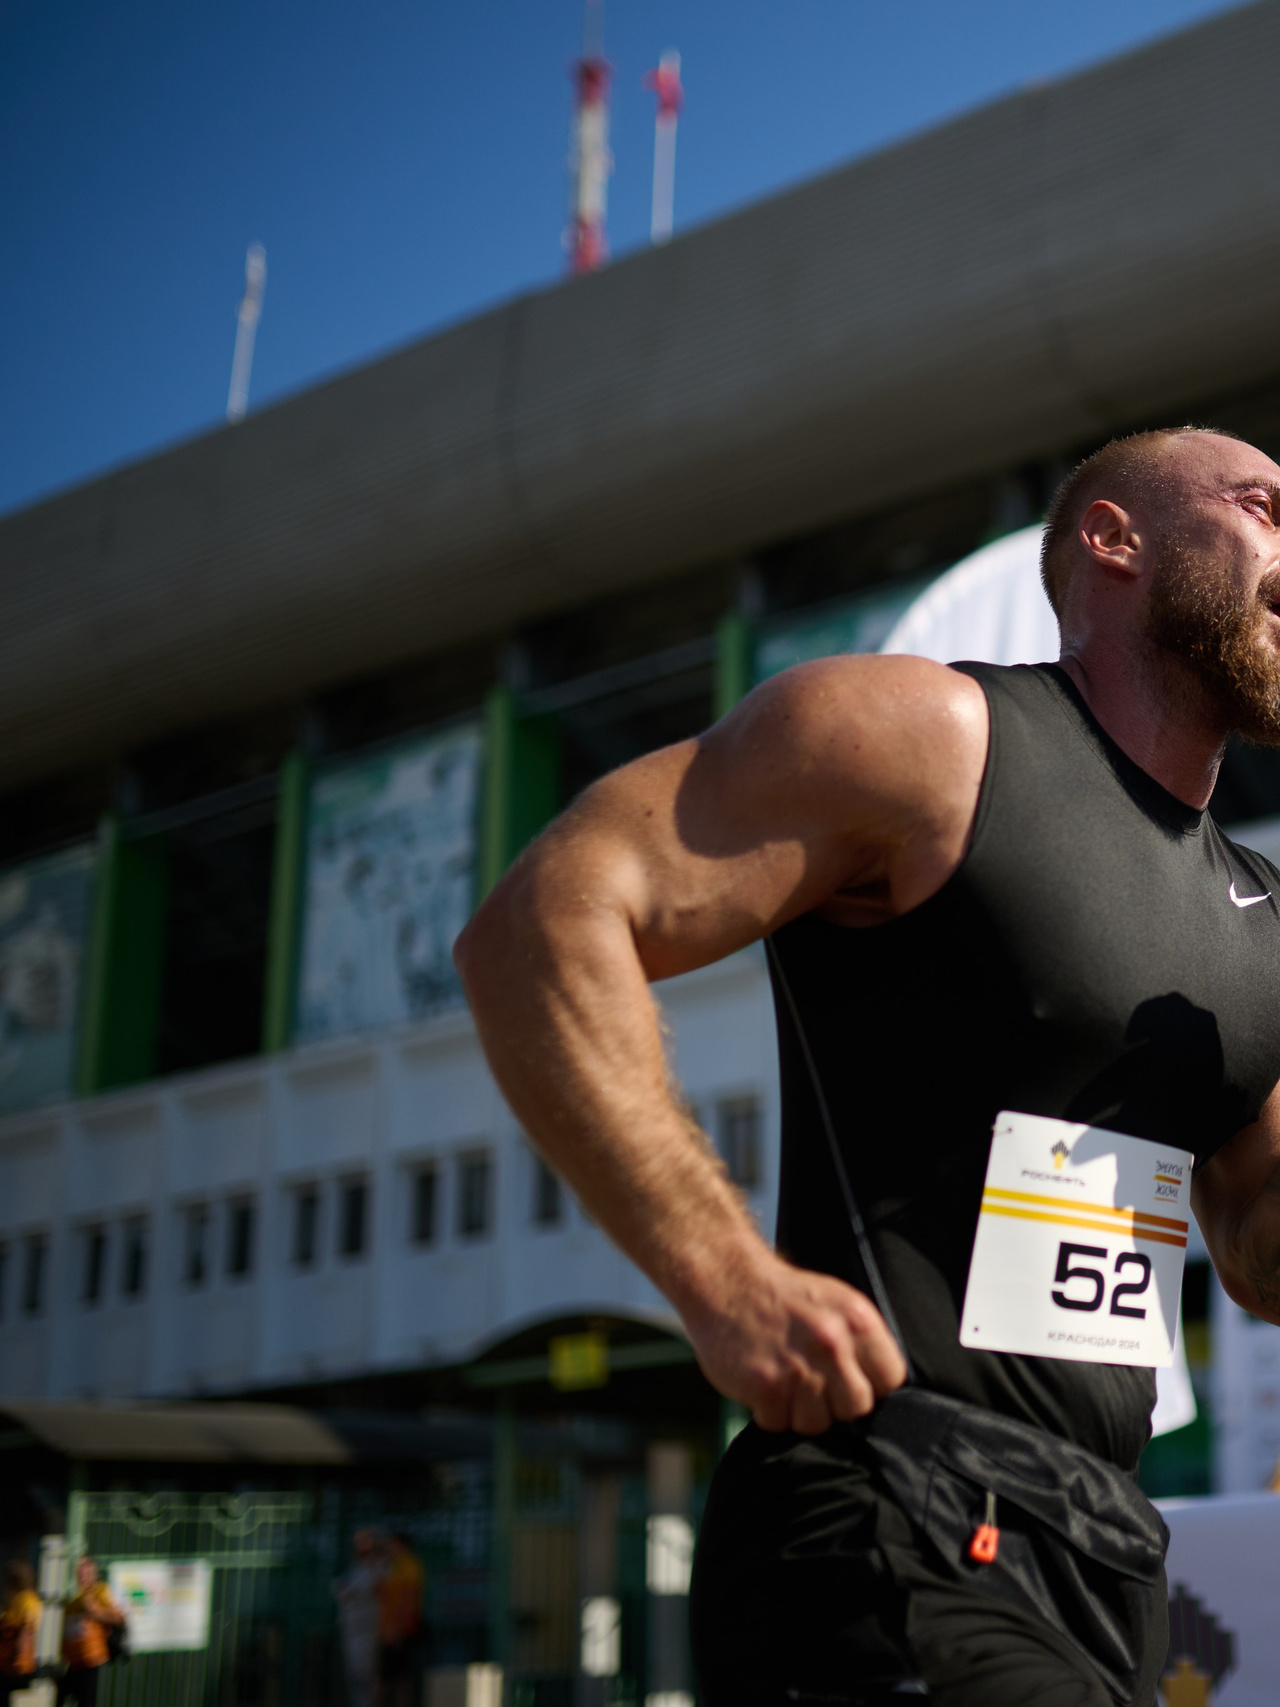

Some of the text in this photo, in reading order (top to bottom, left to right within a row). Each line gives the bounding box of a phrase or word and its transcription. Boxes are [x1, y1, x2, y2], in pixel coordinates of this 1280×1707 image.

[1021, 1169, 1086, 1187] РОСНЕФТЬ
[1051, 1241, 1152, 1320] 52
[1047, 1331, 1140, 1350] КРАСНОДАР 2024
